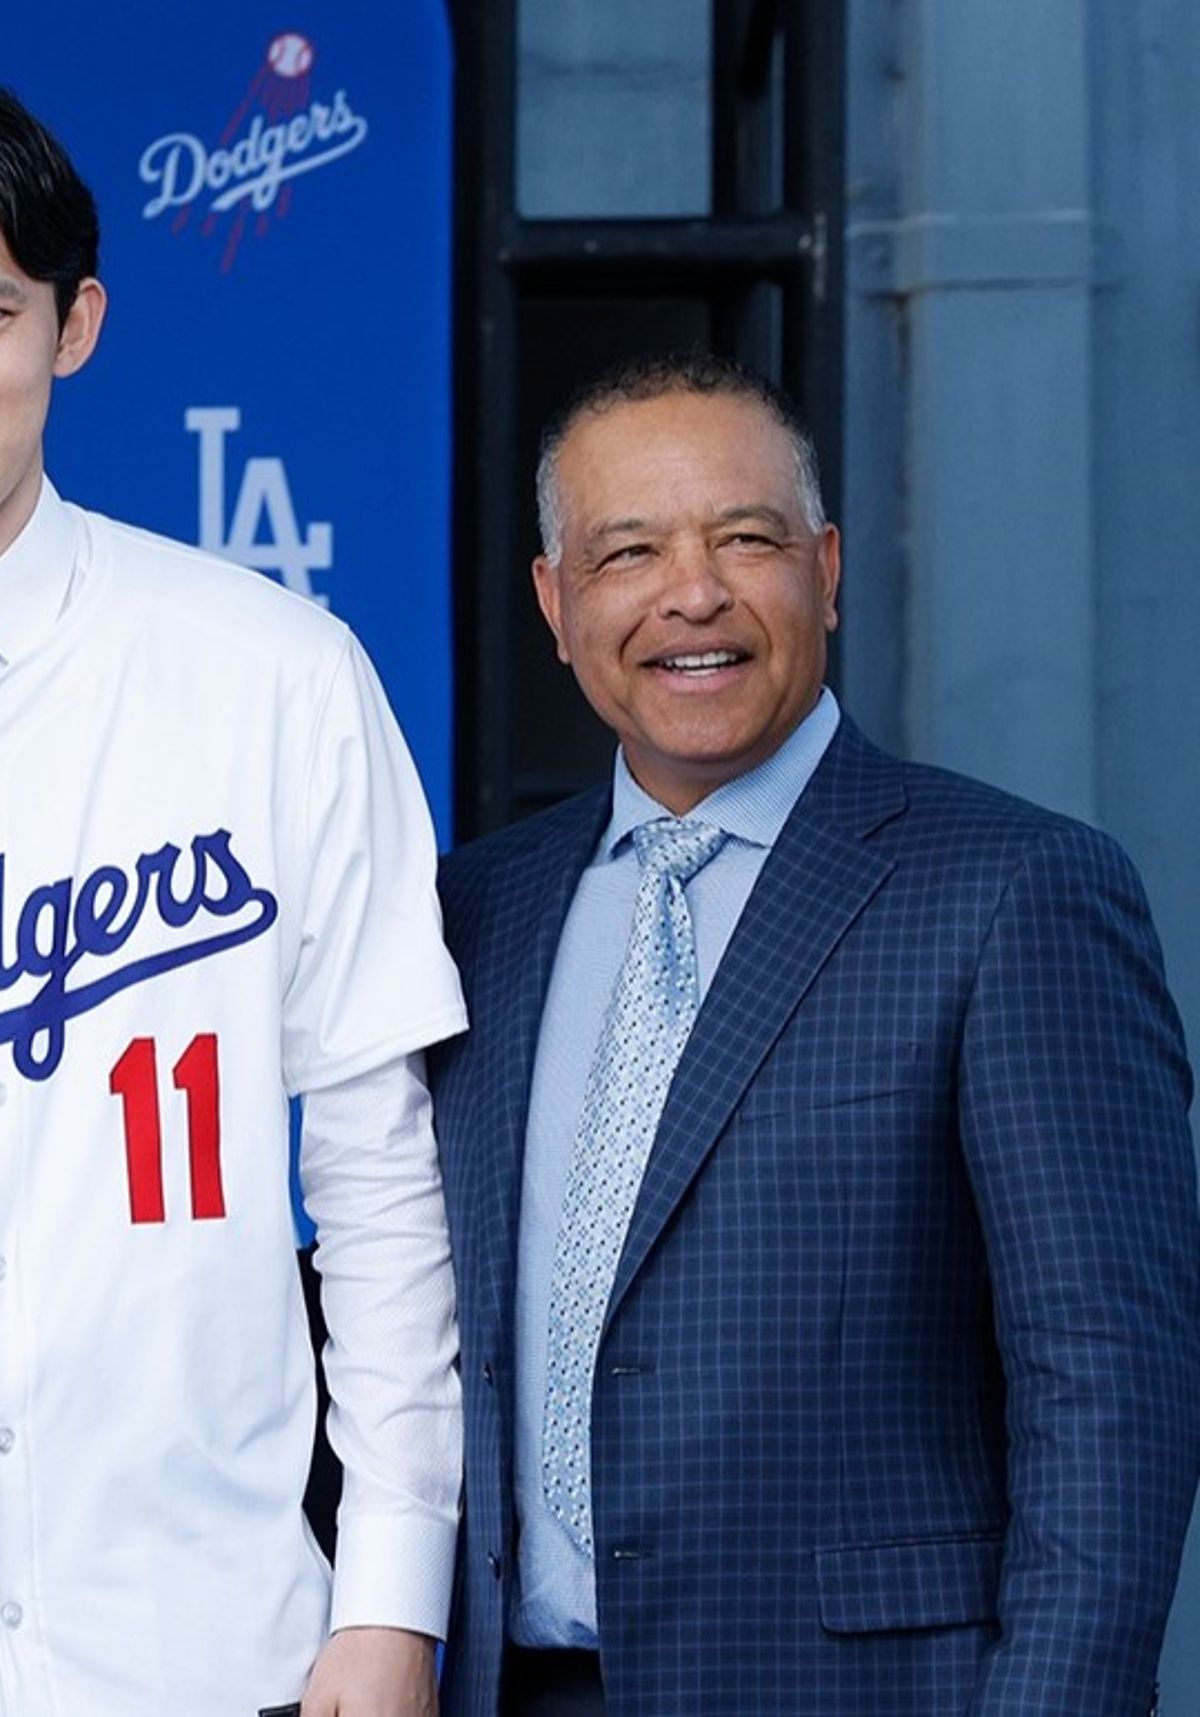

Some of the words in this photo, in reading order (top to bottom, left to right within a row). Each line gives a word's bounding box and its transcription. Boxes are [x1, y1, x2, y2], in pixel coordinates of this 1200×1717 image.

[140, 89, 367, 218] Dodgers
[186, 407, 332, 610] LA
[109, 1033, 226, 1224] 11
